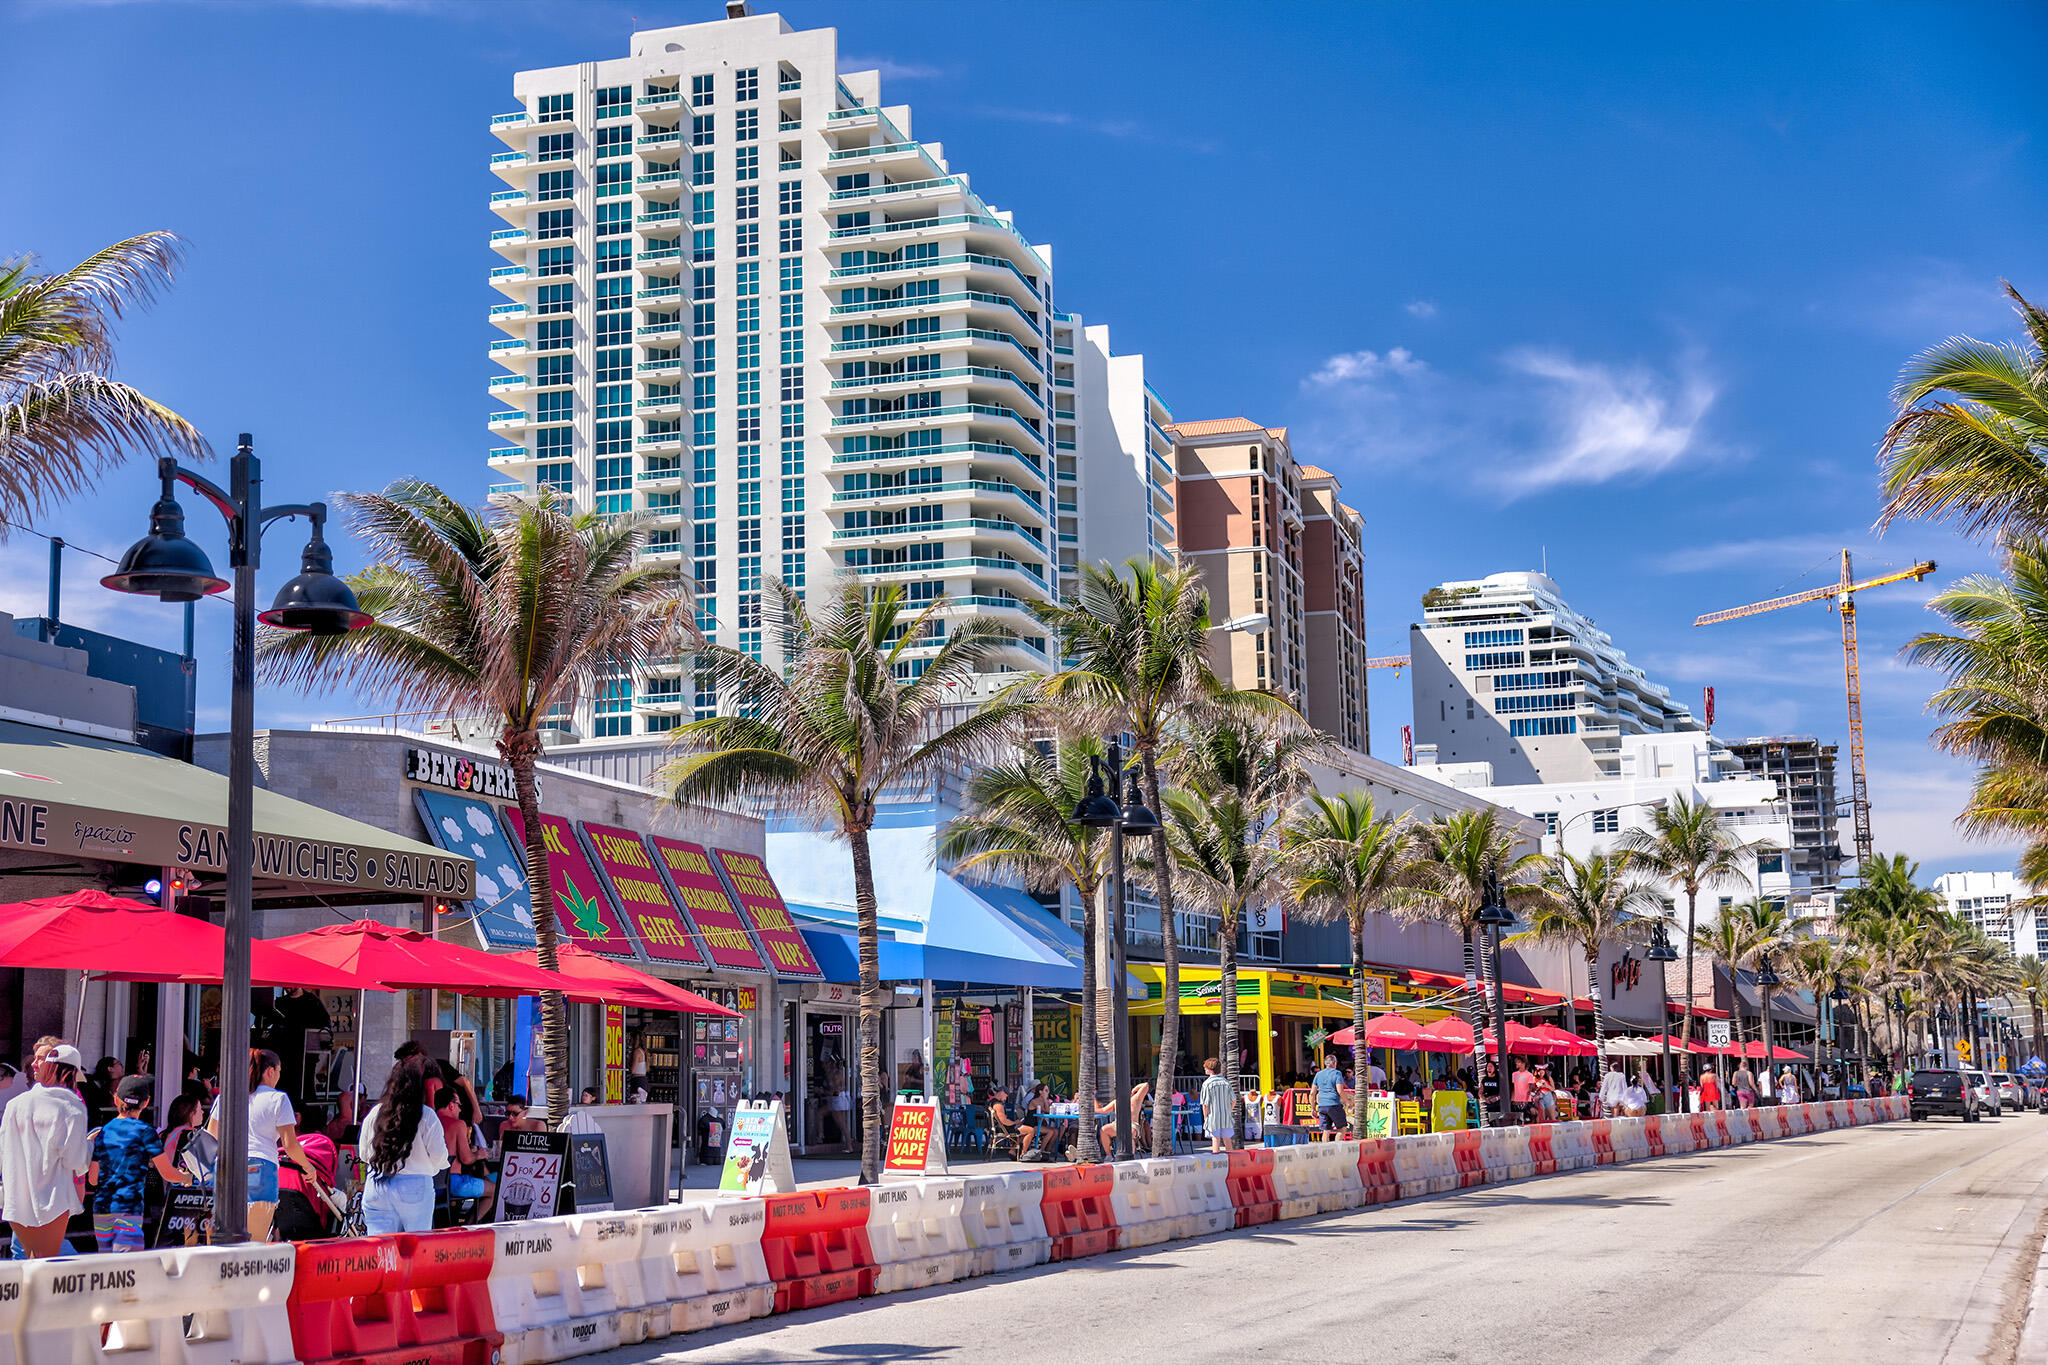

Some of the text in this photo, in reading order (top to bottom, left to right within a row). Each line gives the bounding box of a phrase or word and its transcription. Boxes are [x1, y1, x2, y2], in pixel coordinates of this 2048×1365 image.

[415, 750, 457, 789] BEN
[472, 763, 544, 804] JERRS
[540, 823, 571, 856] HC
[590, 832, 651, 871] T-SHIRTS
[176, 825, 469, 896] SANWICHES SALADS
[660, 846, 714, 877] SWIMWEAR
[722, 852, 768, 879] ORGANIC
[612, 874, 671, 908] SOUVENIRS
[679, 885, 735, 916] BEACHWEAR
[733, 875, 778, 901] TATTOOS
[637, 913, 686, 948] GIFTS
[748, 904, 794, 933] SMOKE
[698, 923, 754, 952] FOOTWEAR
[767, 939, 811, 969] VAPE
[1033, 1020, 1068, 1039] THC
[1711, 1034, 1728, 1045] 30
[606, 1026, 622, 1066] BIG
[606, 1070, 622, 1101] SALE
[902, 1111, 925, 1125] THC
[1378, 1102, 1390, 1110] THC
[893, 1127, 928, 1142] SMOKE
[893, 1142, 926, 1157] VAPE
[504, 1155, 519, 1178] 5
[519, 1166, 533, 1176] FOR
[531, 1156, 559, 1180] $24
[878, 1192, 890, 1204] MOT
[891, 1190, 908, 1203] PLANS
[969, 1186, 980, 1197] MOT
[980, 1184, 995, 1196] PLANS
[772, 1206, 786, 1218] MOT
[787, 1202, 806, 1216] PLANS
[167, 1216, 196, 1232] 50%
[652, 1222, 668, 1236] MOT
[670, 1219, 692, 1233] PLANS
[505, 1238, 553, 1257] MOT PLANS
[316, 1258, 342, 1276] MOT
[344, 1255, 379, 1272] PLANS
[52, 1273, 86, 1295] MOT
[90, 1269, 136, 1292] PLANS
[572, 1322, 597, 1339] YODOCK
